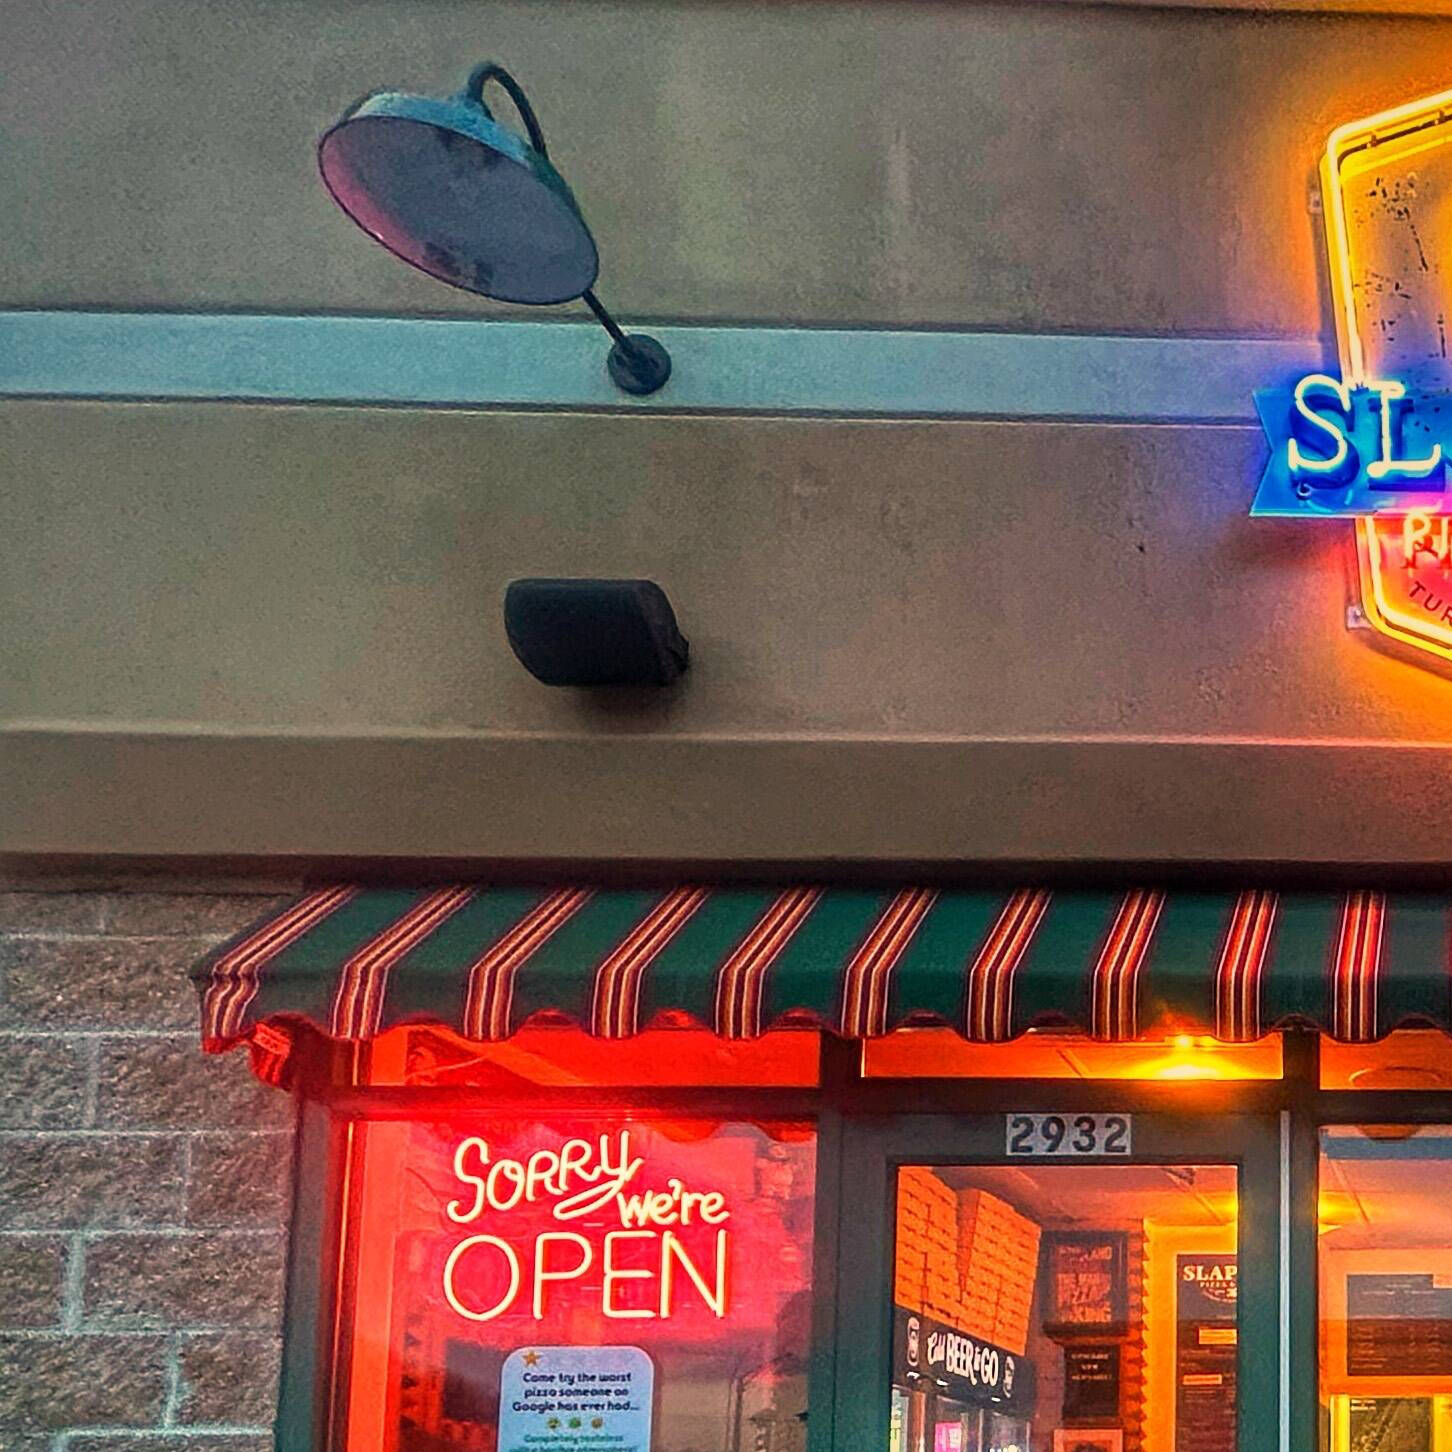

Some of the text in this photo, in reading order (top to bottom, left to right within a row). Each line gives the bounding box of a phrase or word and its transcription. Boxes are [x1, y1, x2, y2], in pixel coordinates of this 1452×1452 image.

[1010, 1115, 1129, 1153] 2932
[616, 1178, 731, 1229] we're
[443, 1228, 729, 1322] OPEN
[1183, 1264, 1238, 1281] SLAP
[523, 1372, 632, 1385] Come try the worst
[980, 1347, 999, 1387] GO
[524, 1386, 630, 1399] pizza someone on
[512, 1401, 556, 1414] Google
[556, 1401, 579, 1411] has
[580, 1402, 606, 1411] ever
